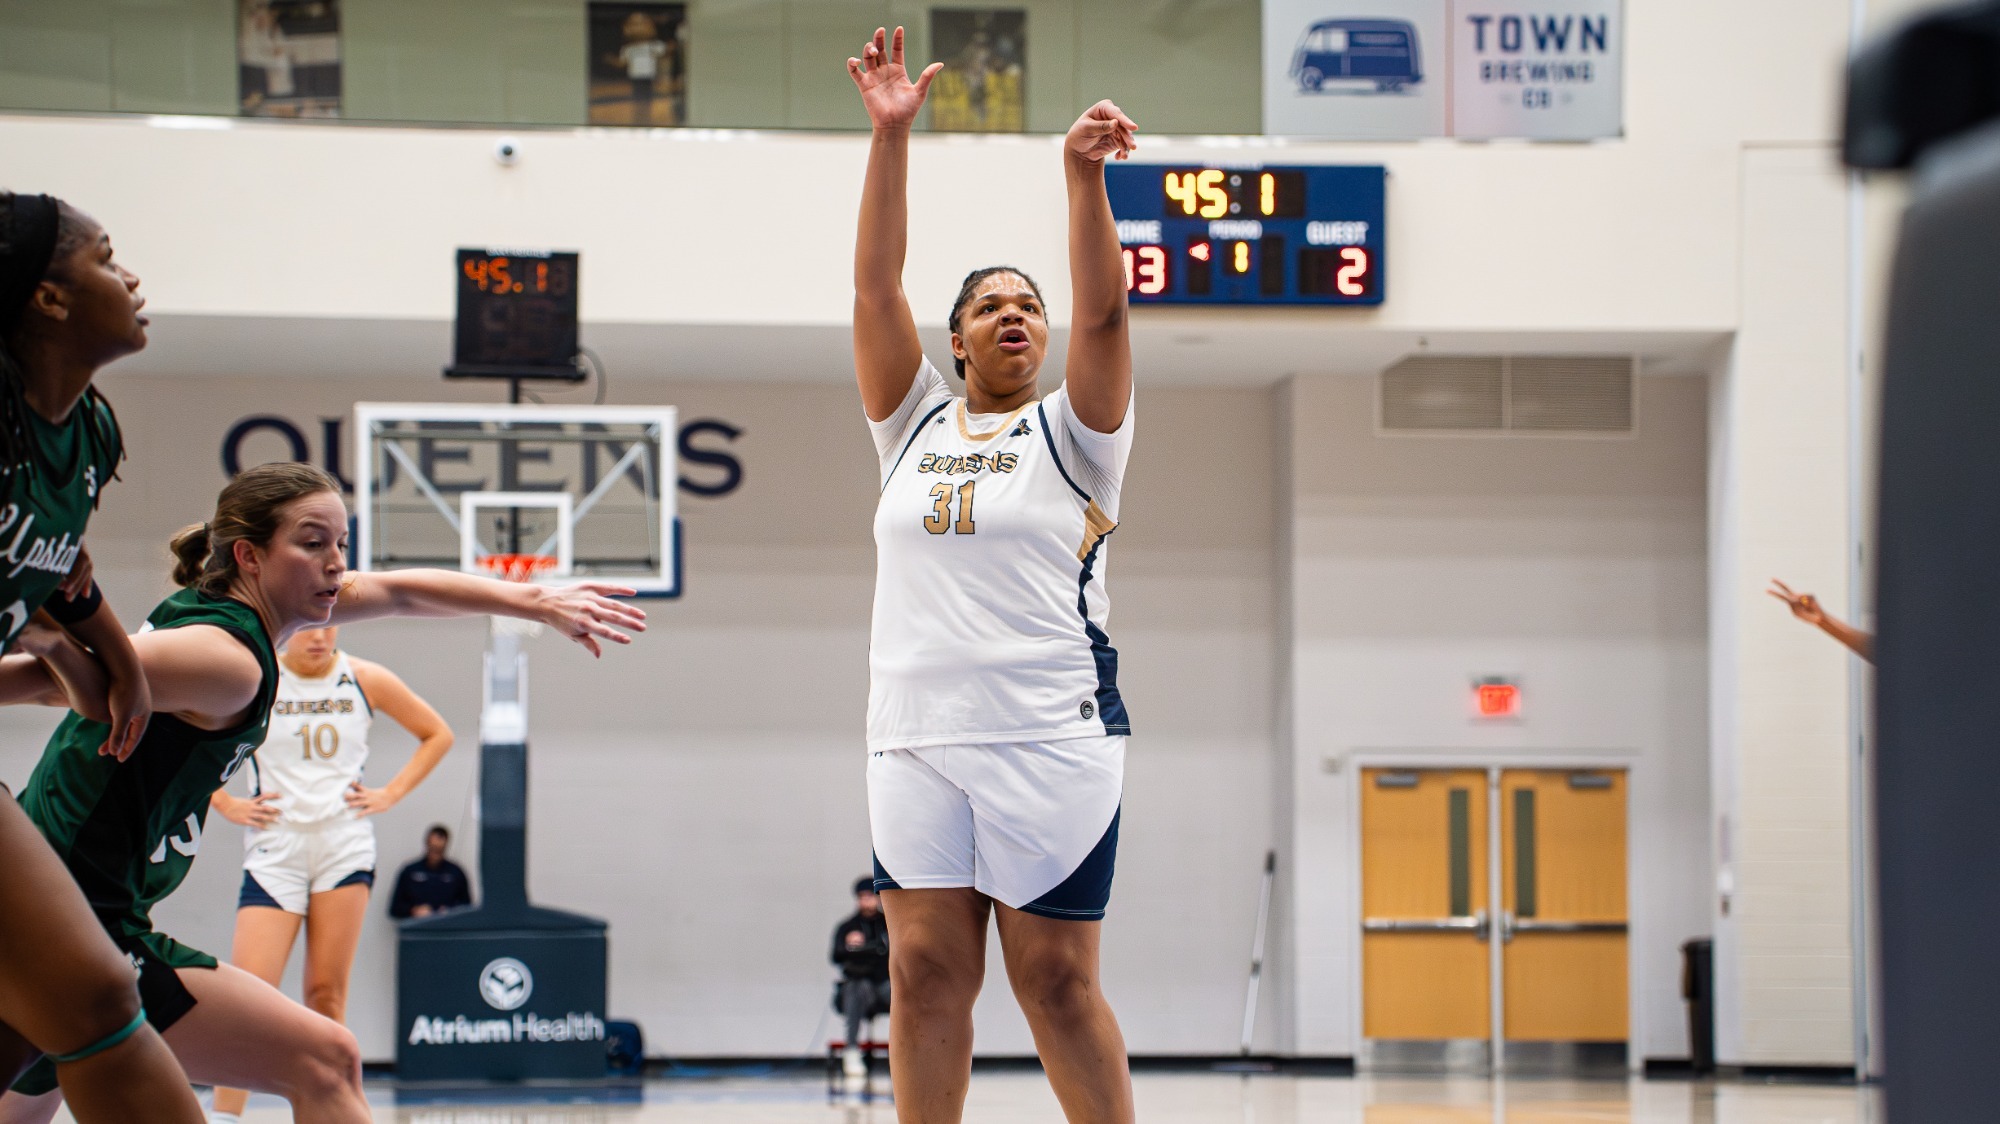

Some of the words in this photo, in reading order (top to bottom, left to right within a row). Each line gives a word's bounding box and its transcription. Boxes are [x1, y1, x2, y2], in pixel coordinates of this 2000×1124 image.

[1467, 15, 1607, 53] TOWN
[1480, 61, 1594, 82] BREWING
[1115, 220, 1162, 244] OME
[1306, 221, 1369, 244] GUEST
[1234, 241, 1249, 273] 1
[1337, 248, 1367, 296] 2
[917, 450, 1019, 475] QUEENS
[923, 480, 976, 535] 31
[274, 699, 353, 715] QUEENS
[295, 723, 339, 759] 10
[408, 1014, 511, 1045] Atrium
[512, 1011, 605, 1042] Health
